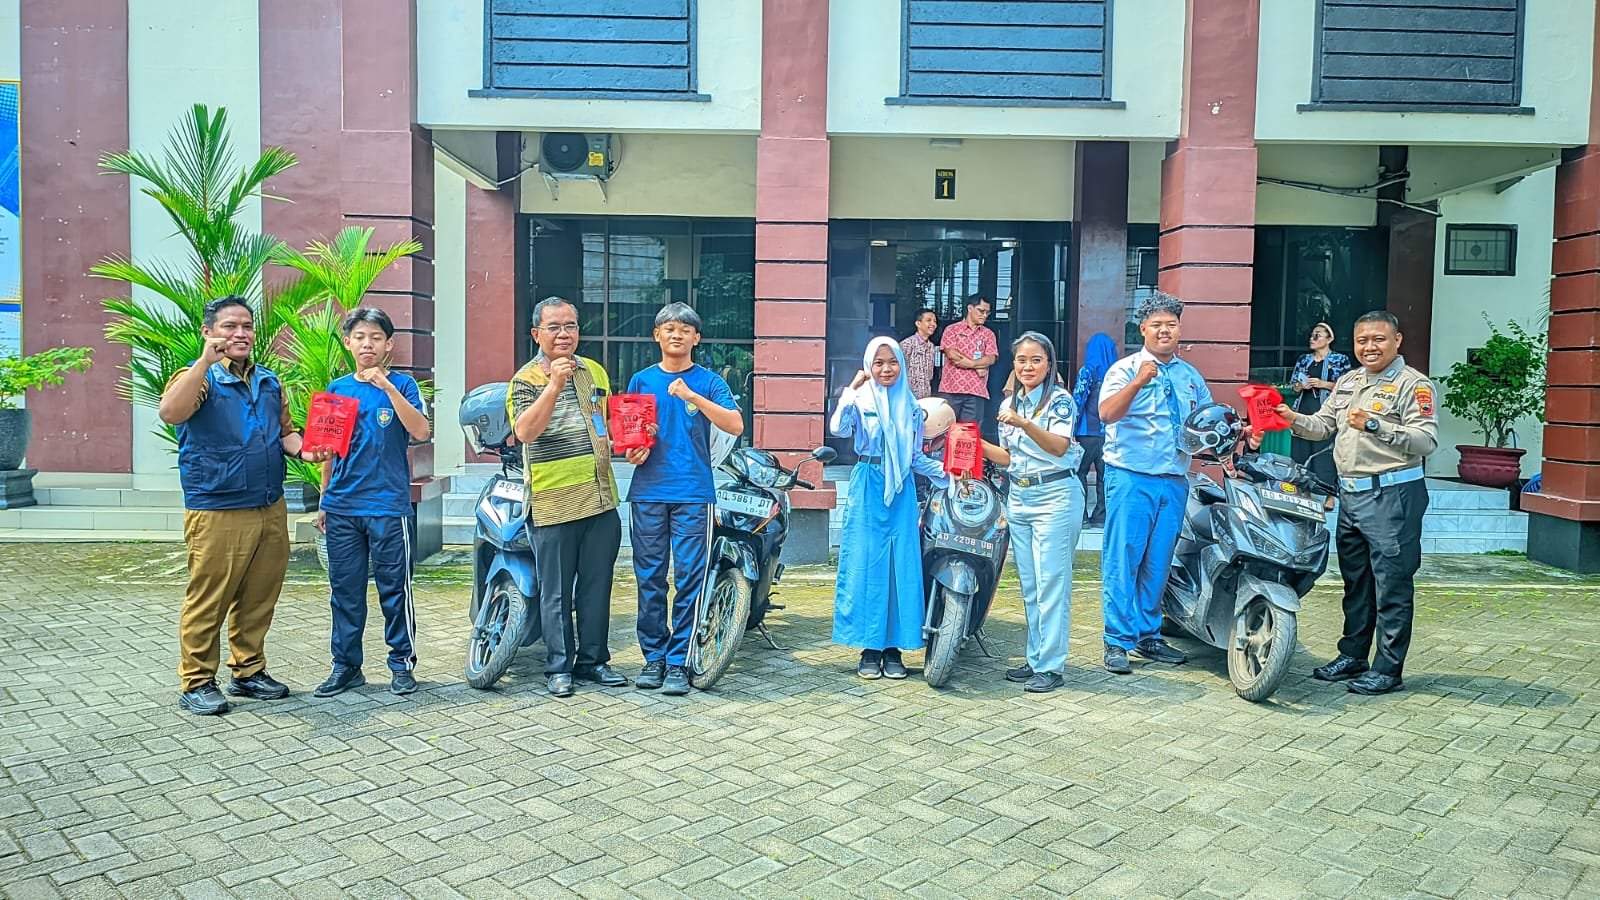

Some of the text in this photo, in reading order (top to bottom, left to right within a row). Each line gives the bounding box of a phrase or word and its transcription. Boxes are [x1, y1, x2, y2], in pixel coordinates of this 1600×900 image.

[942, 180, 948, 196] 1
[1372, 392, 1396, 402] POLRI
[317, 415, 340, 424] AYO
[955, 440, 972, 449] AYO
[731, 493, 753, 505] 5861
[936, 533, 949, 541] AD
